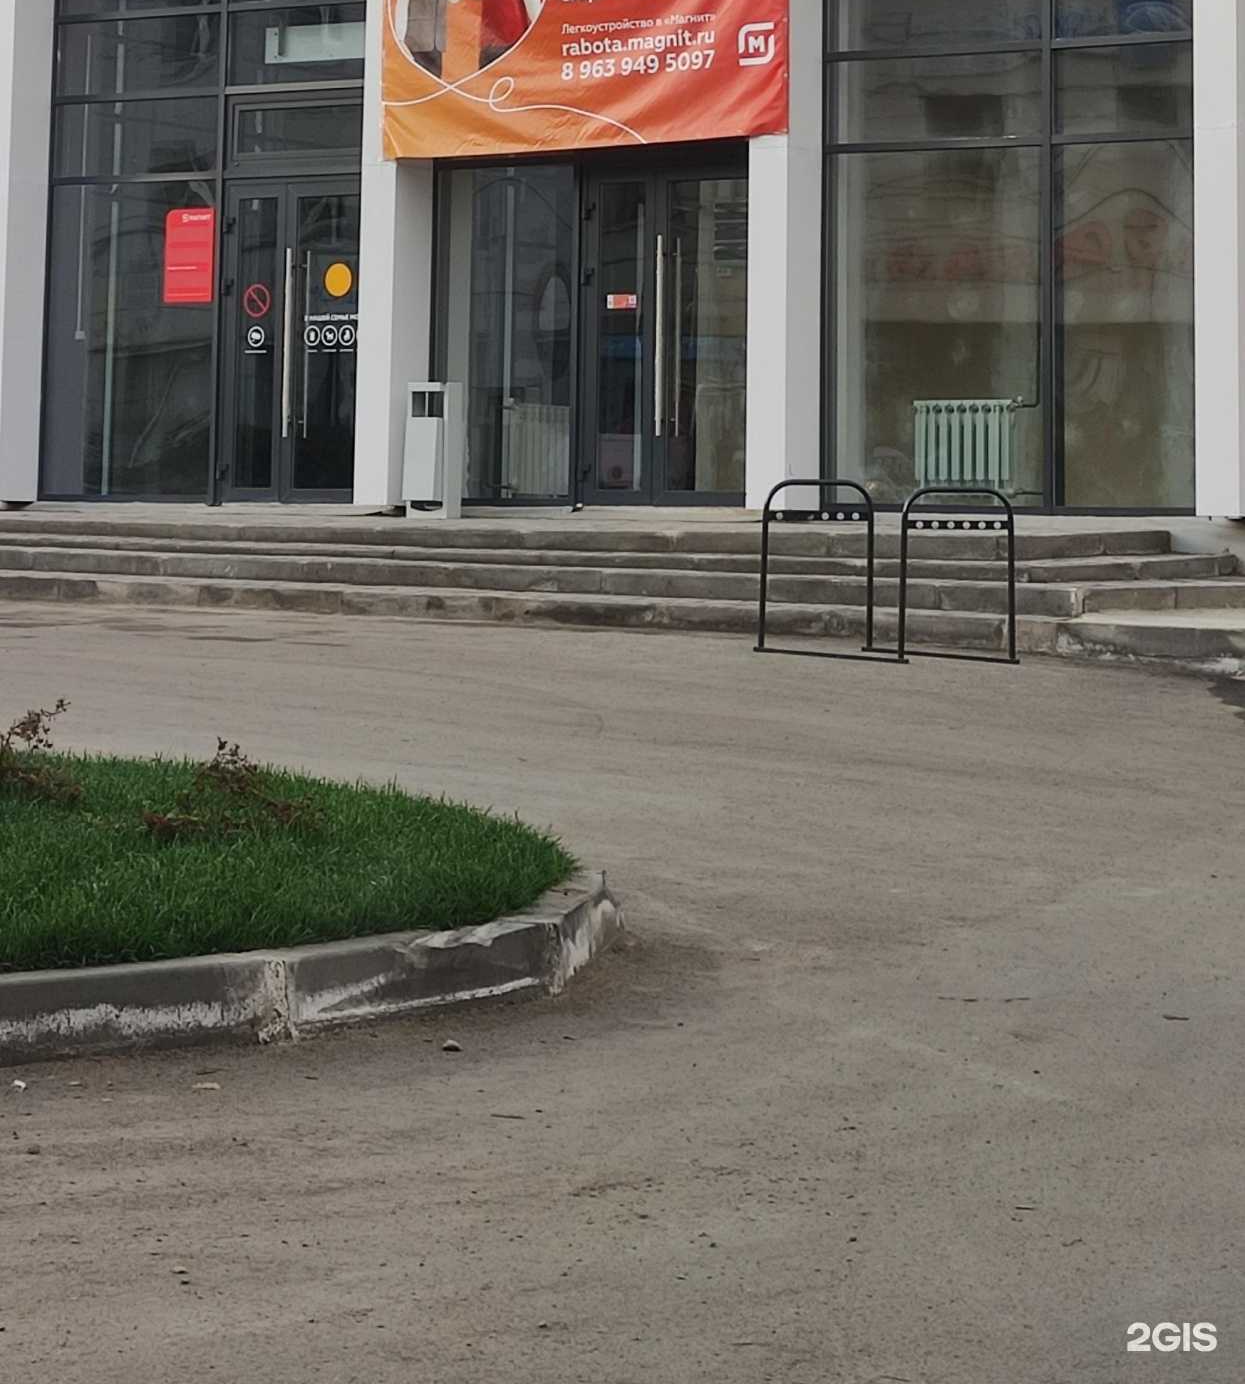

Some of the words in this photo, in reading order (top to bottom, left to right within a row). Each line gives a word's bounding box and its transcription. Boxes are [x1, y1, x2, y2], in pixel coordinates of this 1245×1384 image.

[561, 18, 654, 35] Легкоустройство
[561, 29, 715, 56] rabota.magnit.ru
[561, 62, 574, 81] 8
[579, 58, 616, 79] 963
[620, 54, 660, 76] 949
[665, 49, 716, 73] 5097
